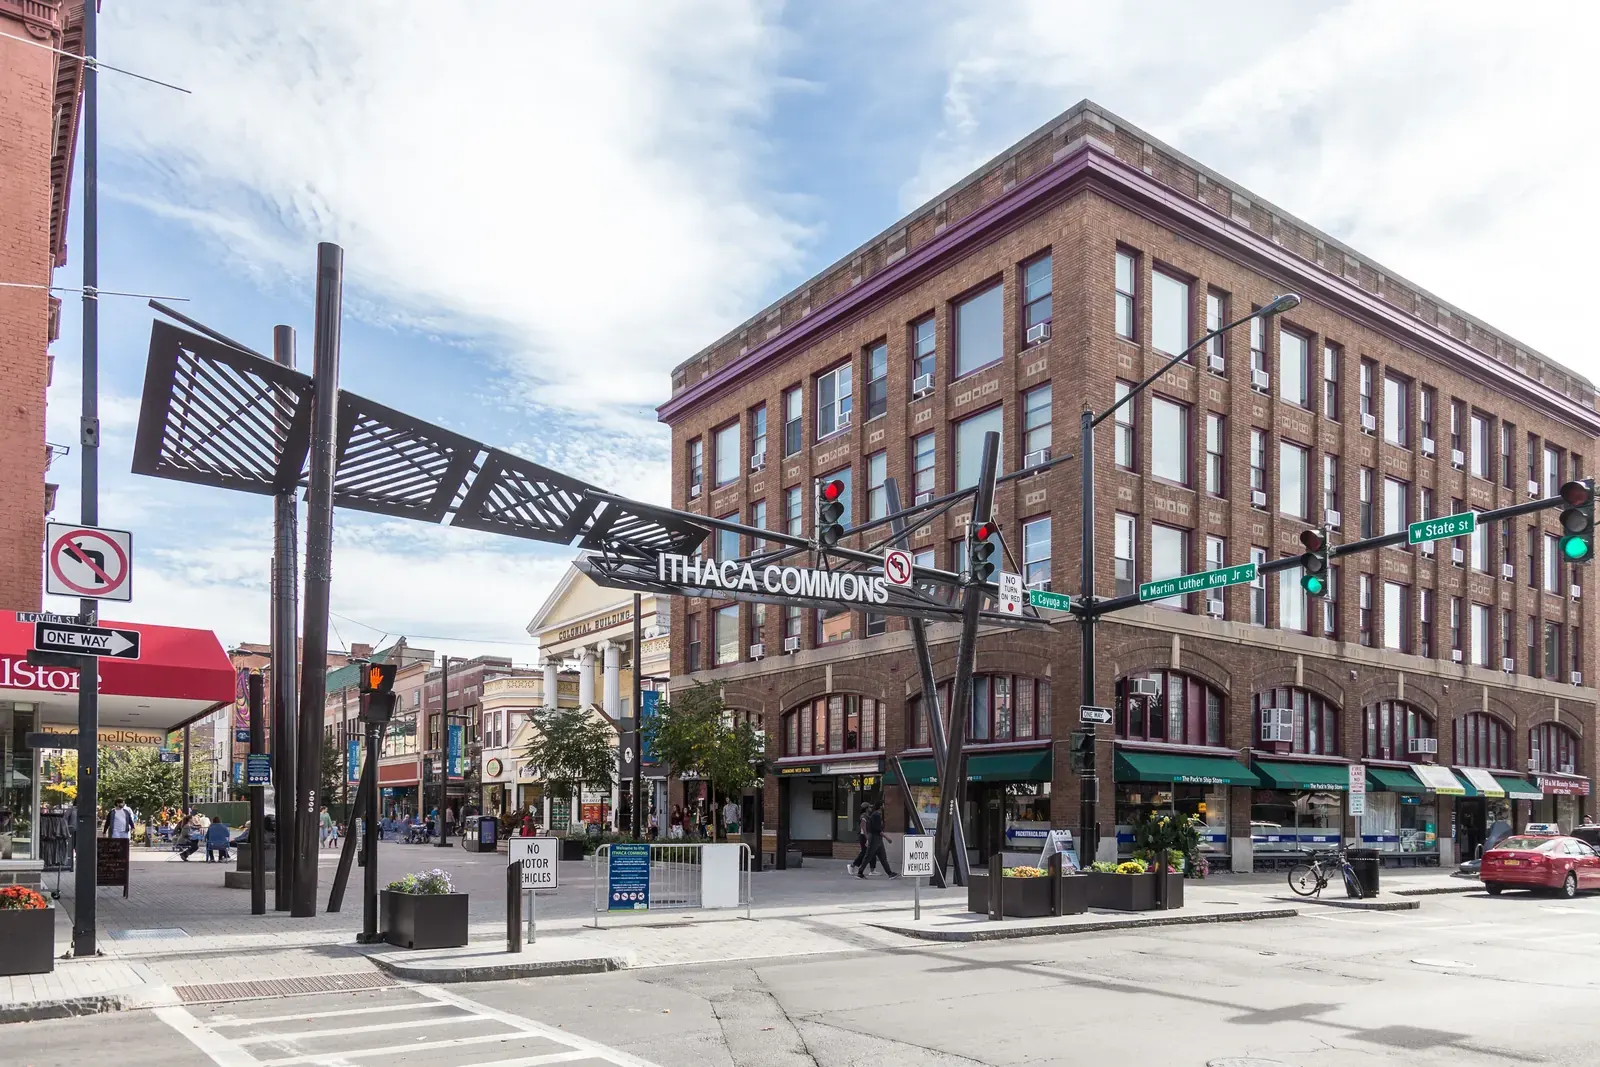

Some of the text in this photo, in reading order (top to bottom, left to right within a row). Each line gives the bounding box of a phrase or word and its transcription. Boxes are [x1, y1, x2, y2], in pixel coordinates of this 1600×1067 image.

[1425, 522, 1455, 537] State
[1458, 520, 1468, 531] St
[659, 552, 889, 604] ITHACA COMMONS
[1006, 576, 1016, 584] NO
[1150, 582, 1174, 595] Martin
[1178, 577, 1204, 590] Luther
[1209, 573, 1227, 585] King
[1232, 570, 1240, 580] Jr
[1246, 569, 1253, 578] St
[1004, 585, 1018, 593] TURN
[1011, 594, 1020, 602] RED
[1038, 594, 1060, 608] Cayuga
[29, 614, 62, 624] CAYUGA
[558, 610, 630, 640] COLONIAL BUILDING
[47, 631, 109, 647] ONE WAY
[0, 658, 102, 690] lStor
[527, 844, 540, 854] NO
[915, 840, 923, 848] NO
[910, 852, 929, 860] MOTOR
[908, 863, 930, 871] VEHICLES
[522, 873, 551, 882] EHICLES
